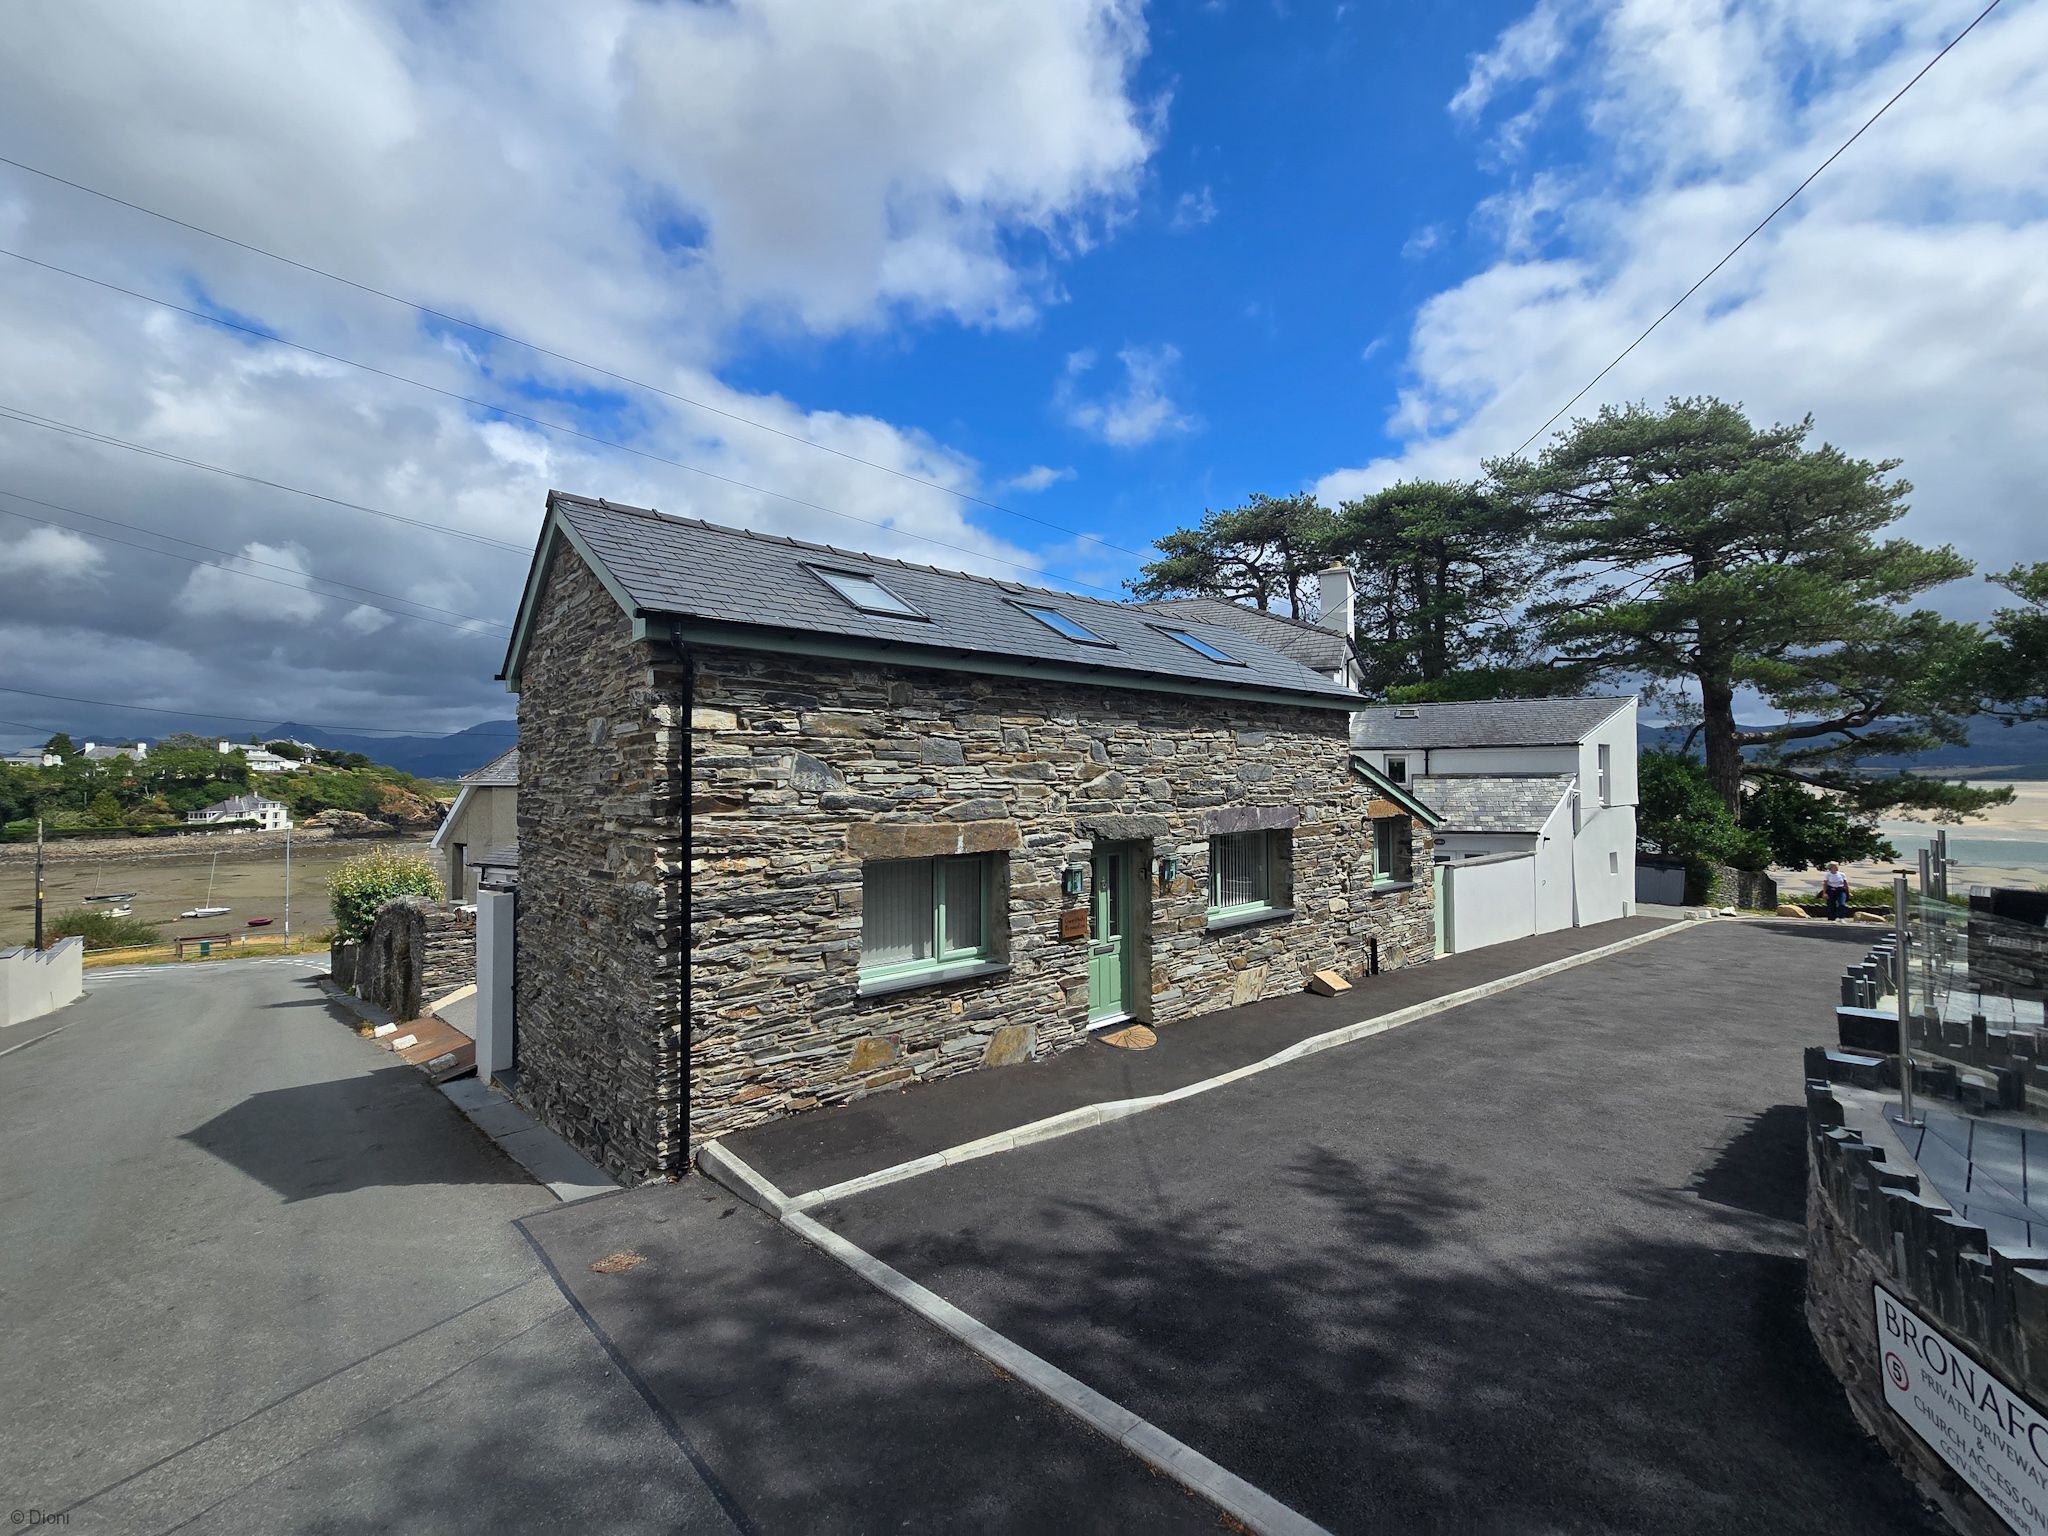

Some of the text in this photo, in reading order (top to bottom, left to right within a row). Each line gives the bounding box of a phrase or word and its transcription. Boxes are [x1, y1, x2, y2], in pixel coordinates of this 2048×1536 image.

[1892, 1360, 1902, 1382] 5
[1913, 1395, 2048, 1530] CHURCH ACCESS ON
[1920, 1368, 2048, 1490] PRIVATE DRIVEWAY
[1976, 1436, 1985, 1453] &
[1940, 1439, 1967, 1471] CCTV
[1980, 1480, 2032, 1536] operation
